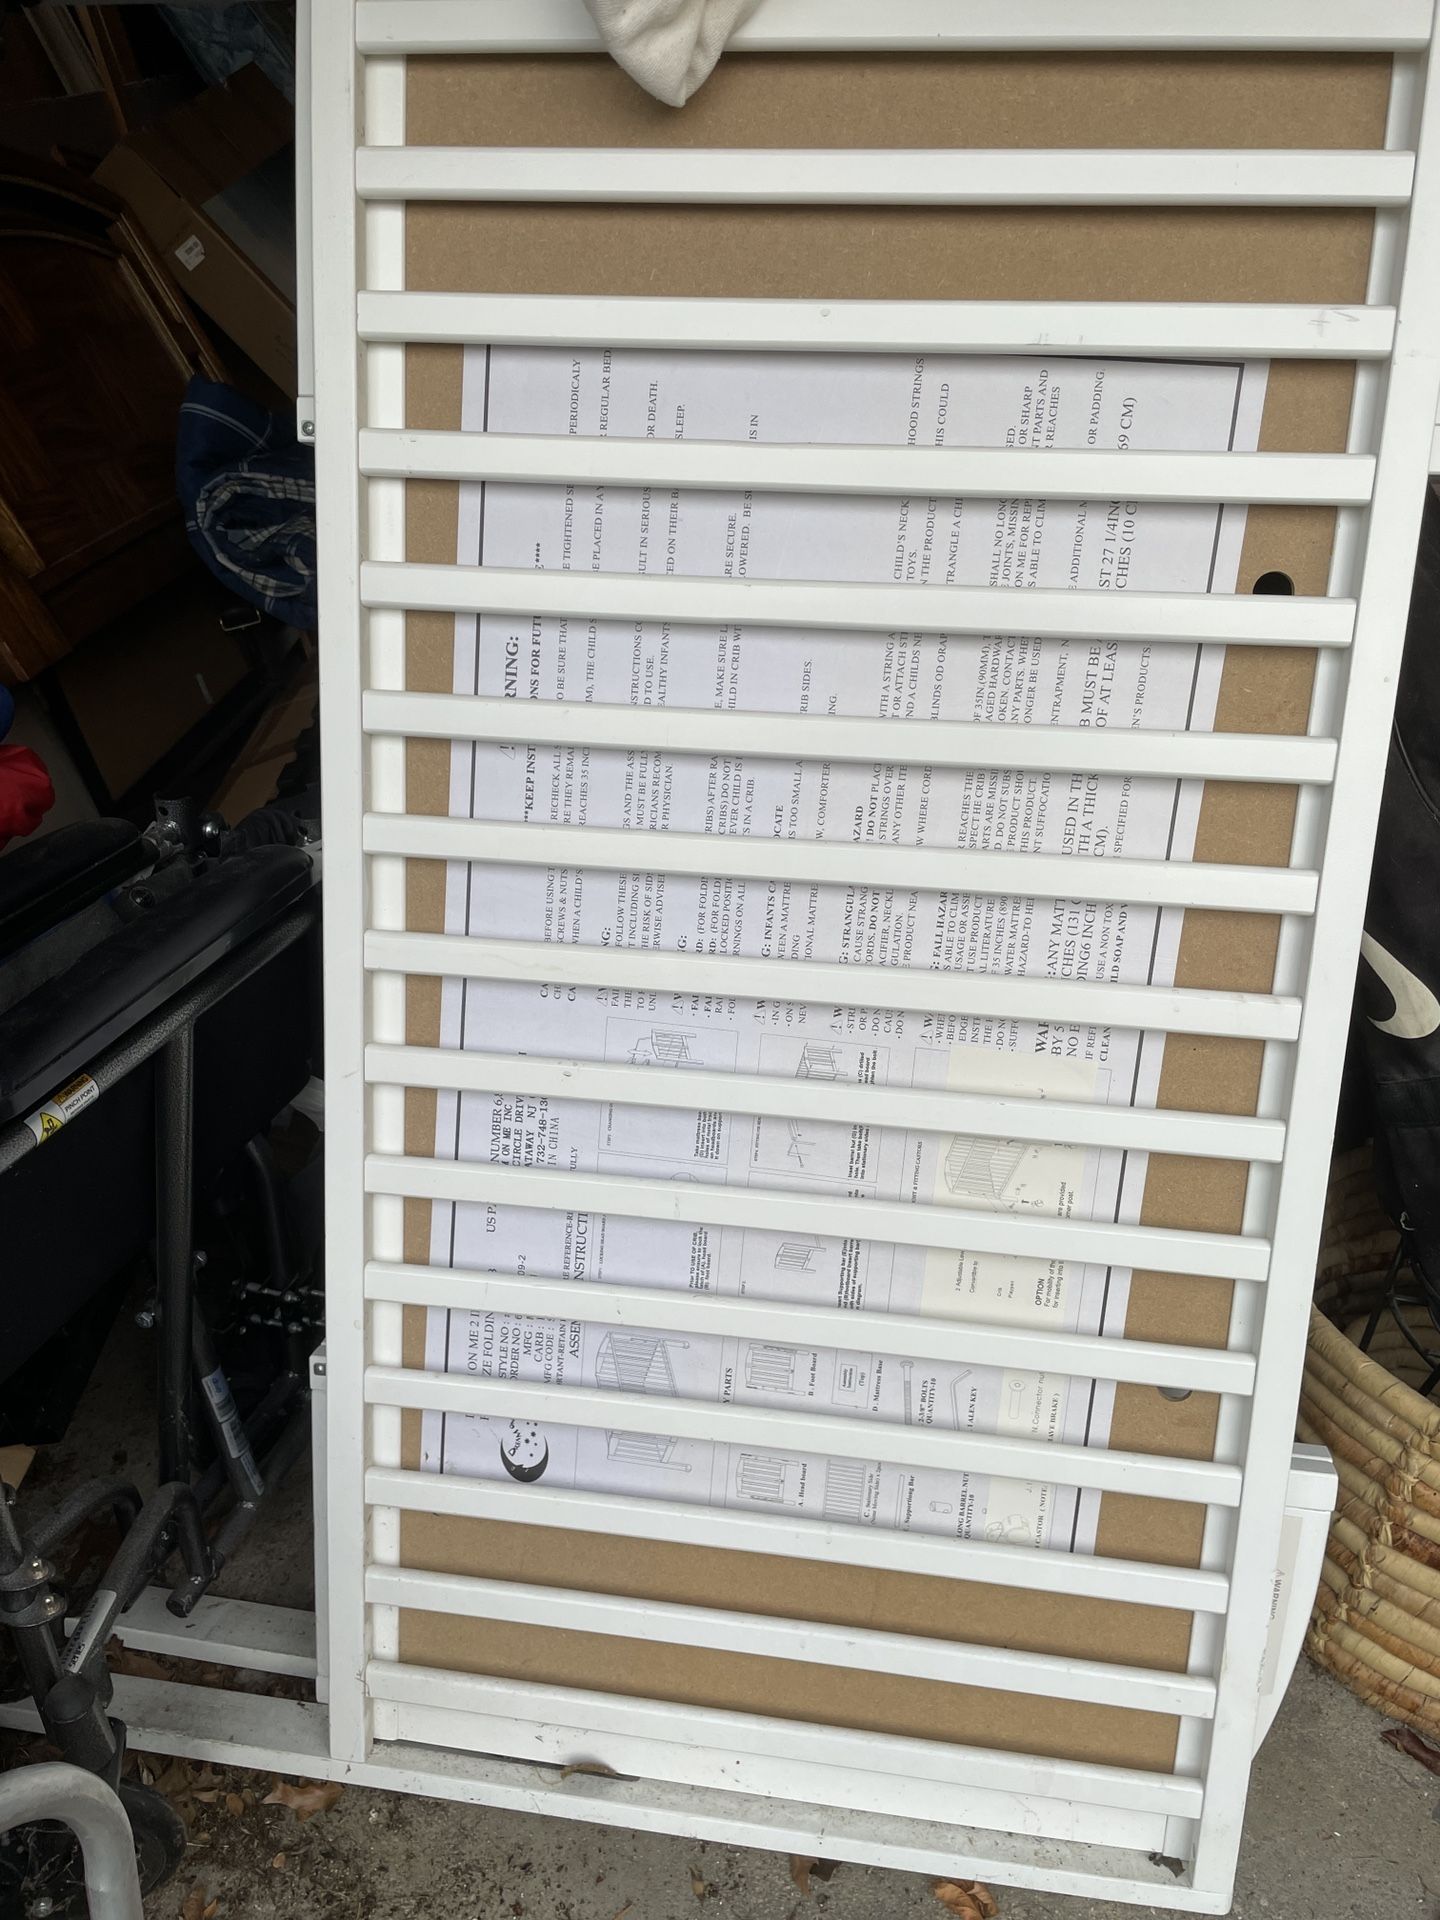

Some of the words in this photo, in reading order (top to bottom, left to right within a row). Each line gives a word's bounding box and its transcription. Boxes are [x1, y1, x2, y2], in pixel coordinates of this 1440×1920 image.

[568, 359, 581, 435] PERIODICALY
[911, 358, 924, 408] STRINGS
[1038, 370, 1048, 396] AND
[600, 376, 611, 432] REGULAR
[648, 380, 658, 422] DEATH.
[937, 383, 950, 425] COULD
[1020, 386, 1033, 426] SHARP
[1034, 398, 1046, 434] PARTS
[1046, 386, 1060, 441] REACHES
[1120, 396, 1138, 430] CM)
[674, 404, 685, 439] SLEEP.
[749, 429, 758, 440] IS
[907, 412, 918, 446] HOOD
[640, 487, 651, 534] SERIOUS
[668, 502, 679, 536] THEIR
[898, 500, 910, 531] NECK
[562, 498, 574, 560] TIGHTENED
[592, 517, 603, 560] PLACED
[725, 512, 737, 558] SECURE.
[1020, 526, 1030, 548] FOR
[1120, 520, 1136, 542] (10
[894, 534, 906, 580] CHILD'S
[1000, 538, 1016, 582] JOINTS,
[1017, 551, 1027, 568] ME
[1070, 512, 1087, 583] ADDITIONAL
[1101, 548, 1114, 565] 27
[906, 549, 918, 581] TOYS.
[921, 554, 932, 577] THE
[1029, 548, 1041, 579] ABLE
[587, 626, 597, 659] CHILD
[730, 644, 741, 670] CRIB
[1088, 646, 1101, 666] BE
[530, 649, 541, 676] FOR
[558, 647, 567, 674] SURE
[586, 661, 595, 682] THE
[646, 655, 655, 678] USE.
[802, 659, 812, 692] SIDES.
[882, 642, 895, 682] STRING
[894, 651, 906, 694] ATTACH
[908, 650, 920, 690] CHILDS
[556, 676, 566, 690] BE
[714, 666, 725, 697] MAKE
[1081, 670, 1098, 714] MUST
[1099, 685, 1112, 704] AT
[552, 751, 561, 771] ALL
[581, 769, 589, 780] 35
[722, 760, 731, 781] NOT
[564, 782, 574, 808] THEY
[625, 771, 634, 791] THE
[638, 782, 646, 795] BE
[662, 763, 674, 820] PHYSICIAN.
[706, 771, 717, 804] AFTER
[720, 783, 730, 798] DO
[732, 774, 742, 806] CHILD
[792, 769, 802, 804] SMALL
[963, 771, 974, 792] THE
[550, 774, 560, 820] RECHECK
[624, 794, 633, 816] AND
[636, 797, 646, 826] MUST
[868, 795, 878, 818] NOT
[894, 784, 906, 819] OTHER
[1022, 777, 1038, 829] PRODUCT.
[790, 807, 799, 828] TOO
[866, 820, 876, 836] DO
[878, 796, 890, 840] STRINGS
[917, 797, 928, 834] WHERE
[958, 794, 972, 842] REACHES
[1007, 798, 1021, 846] PRODUCT
[1114, 799, 1129, 853] SPECIFIED
[1062, 816, 1076, 856] USED
[546, 874, 555, 904] USING
[560, 869, 568, 894] NUTS
[574, 869, 584, 908] CHILD'S
[617, 874, 627, 904] THESE
[737, 882, 746, 901] ALL
[628, 884, 640, 940] INCLUDING
[870, 891, 880, 912] NOT
[556, 908, 566, 944] SCREWS
[642, 910, 652, 930] RISK
[697, 910, 707, 934] (FOR
[710, 910, 720, 934] (FOR
[764, 896, 776, 940] INFANTS
[869, 914, 878, 930] DO
[981, 899, 996, 961] LITERATURE
[1065, 910, 1080, 936] (131
[1117, 911, 1128, 932] AND
[720, 914, 730, 954] LOCKED
[854, 929, 864, 962] CAUSE
[904, 914, 916, 961] PRODUCT
[932, 929, 944, 958] FALL
[994, 918, 1007, 955] INCHES
[1017, 918, 1032, 976] HAZARD-TO
[1100, 926, 1110, 950] NON
[944, 937, 954, 962] ABLE
[955, 936, 966, 970] USAGE
[968, 946, 978, 965] USE
[992, 957, 1001, 968] 35
[1004, 942, 1016, 976] WATER
[1113, 935, 1124, 964] SOAP
[64, 1096, 82, 1112] PINCH
[79, 1085, 96, 1100] POINT
[504, 1104, 512, 1121] INC
[490, 1108, 502, 1163] NUMBER
[503, 1127, 512, 1139] ME
[512, 1128, 523, 1167] CIRCLE
[549, 1117, 560, 1150] CHINA
[486, 1217, 496, 1233] US
[1034, 1278, 1045, 1306] OPTION
[469, 1330, 479, 1348] ME
[470, 1320, 480, 1328] 2
[500, 1327, 510, 1344] NO
[512, 1328, 520, 1344] NO
[523, 1332, 532, 1356] MFG
[534, 1332, 544, 1362] CARB
[545, 1334, 554, 1361] CODE
[499, 1346, 508, 1378] STYLE
[724, 1368, 733, 1396] PARTS
